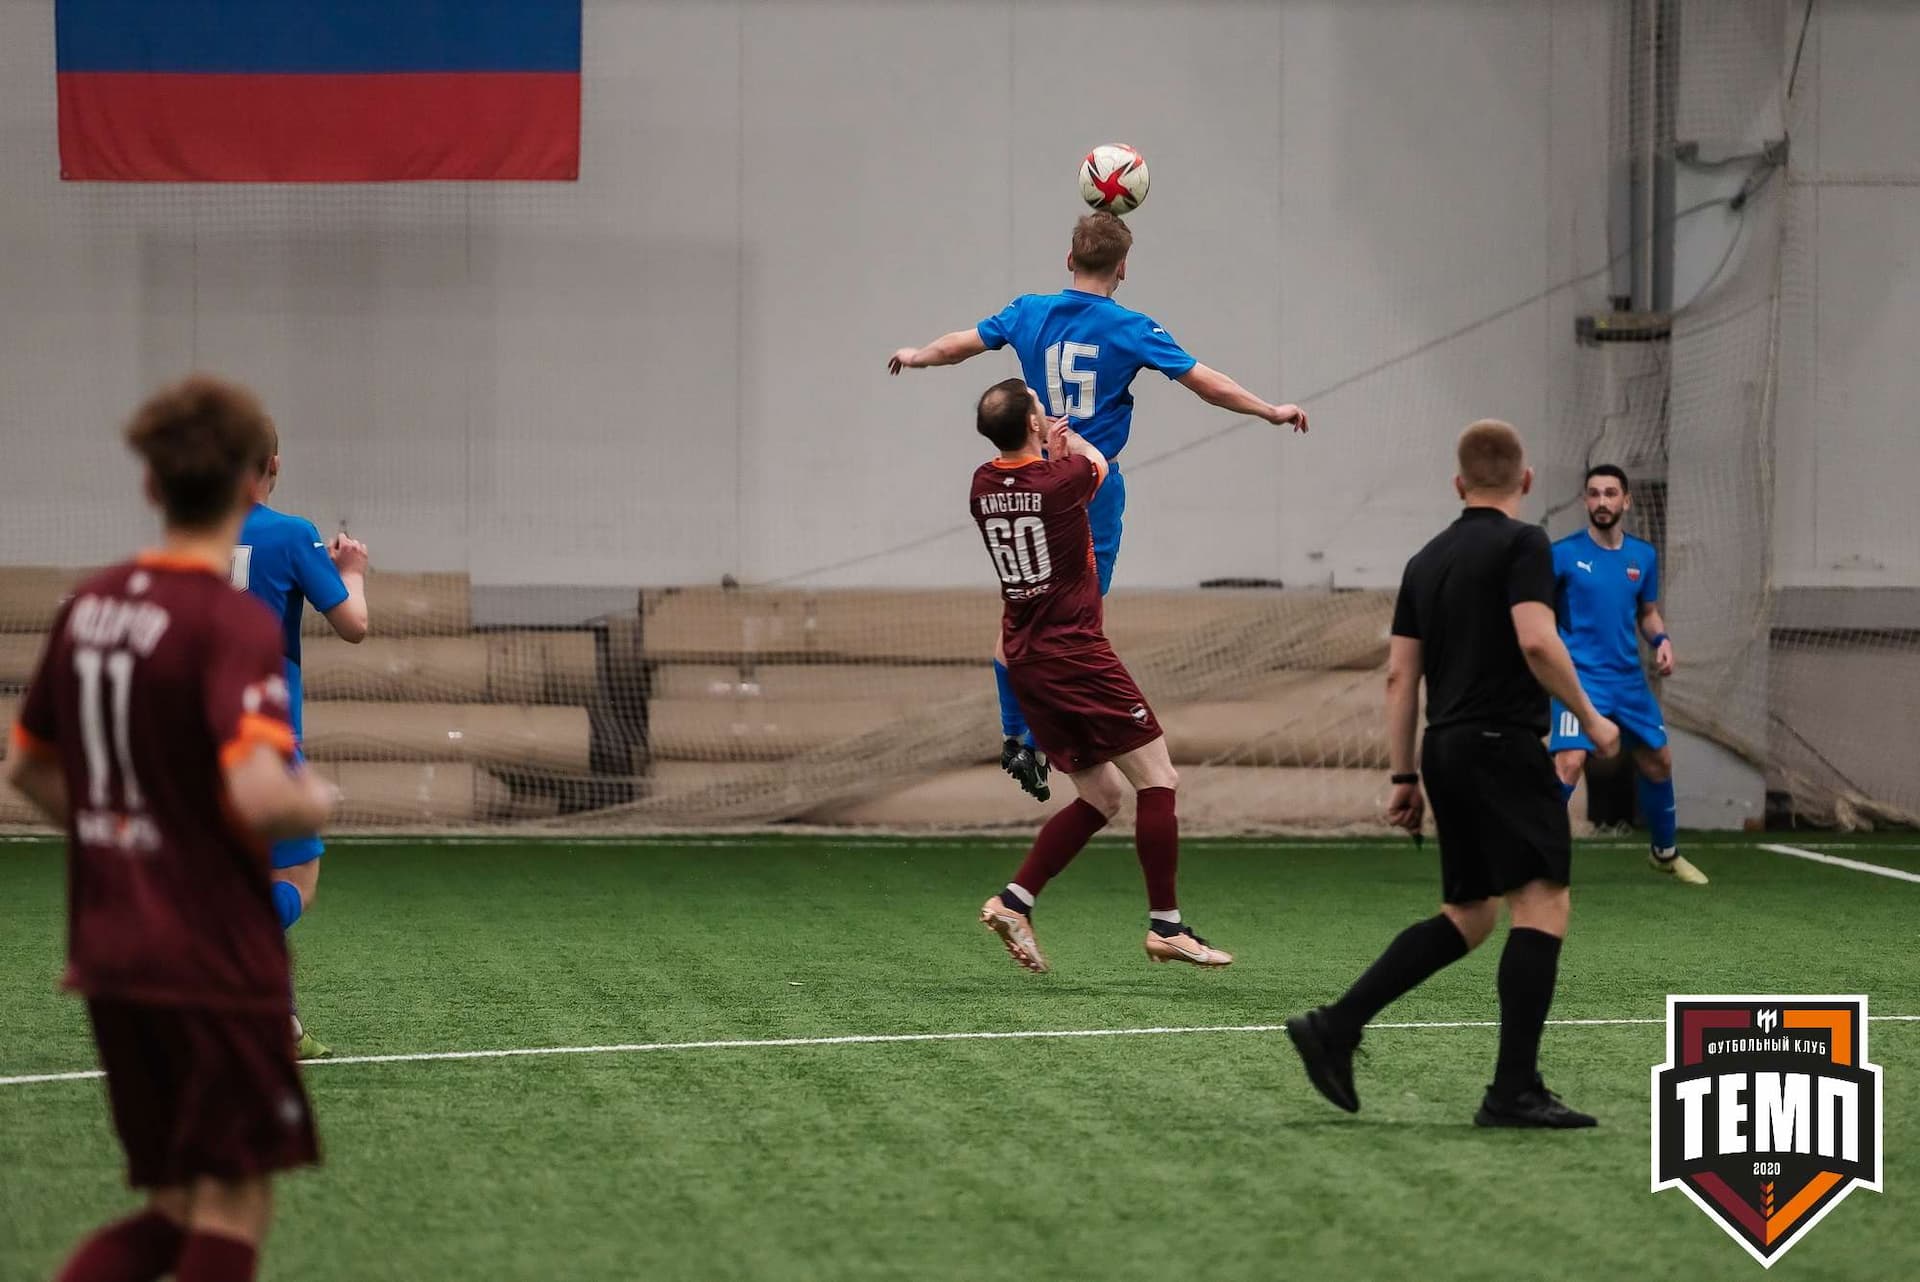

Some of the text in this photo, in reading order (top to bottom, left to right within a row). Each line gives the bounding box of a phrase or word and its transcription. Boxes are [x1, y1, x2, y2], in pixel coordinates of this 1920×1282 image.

[1045, 341, 1099, 419] 15
[980, 492, 1042, 515] КИСЕЛЕВ
[985, 516, 1052, 584] 60
[75, 651, 143, 809] 11
